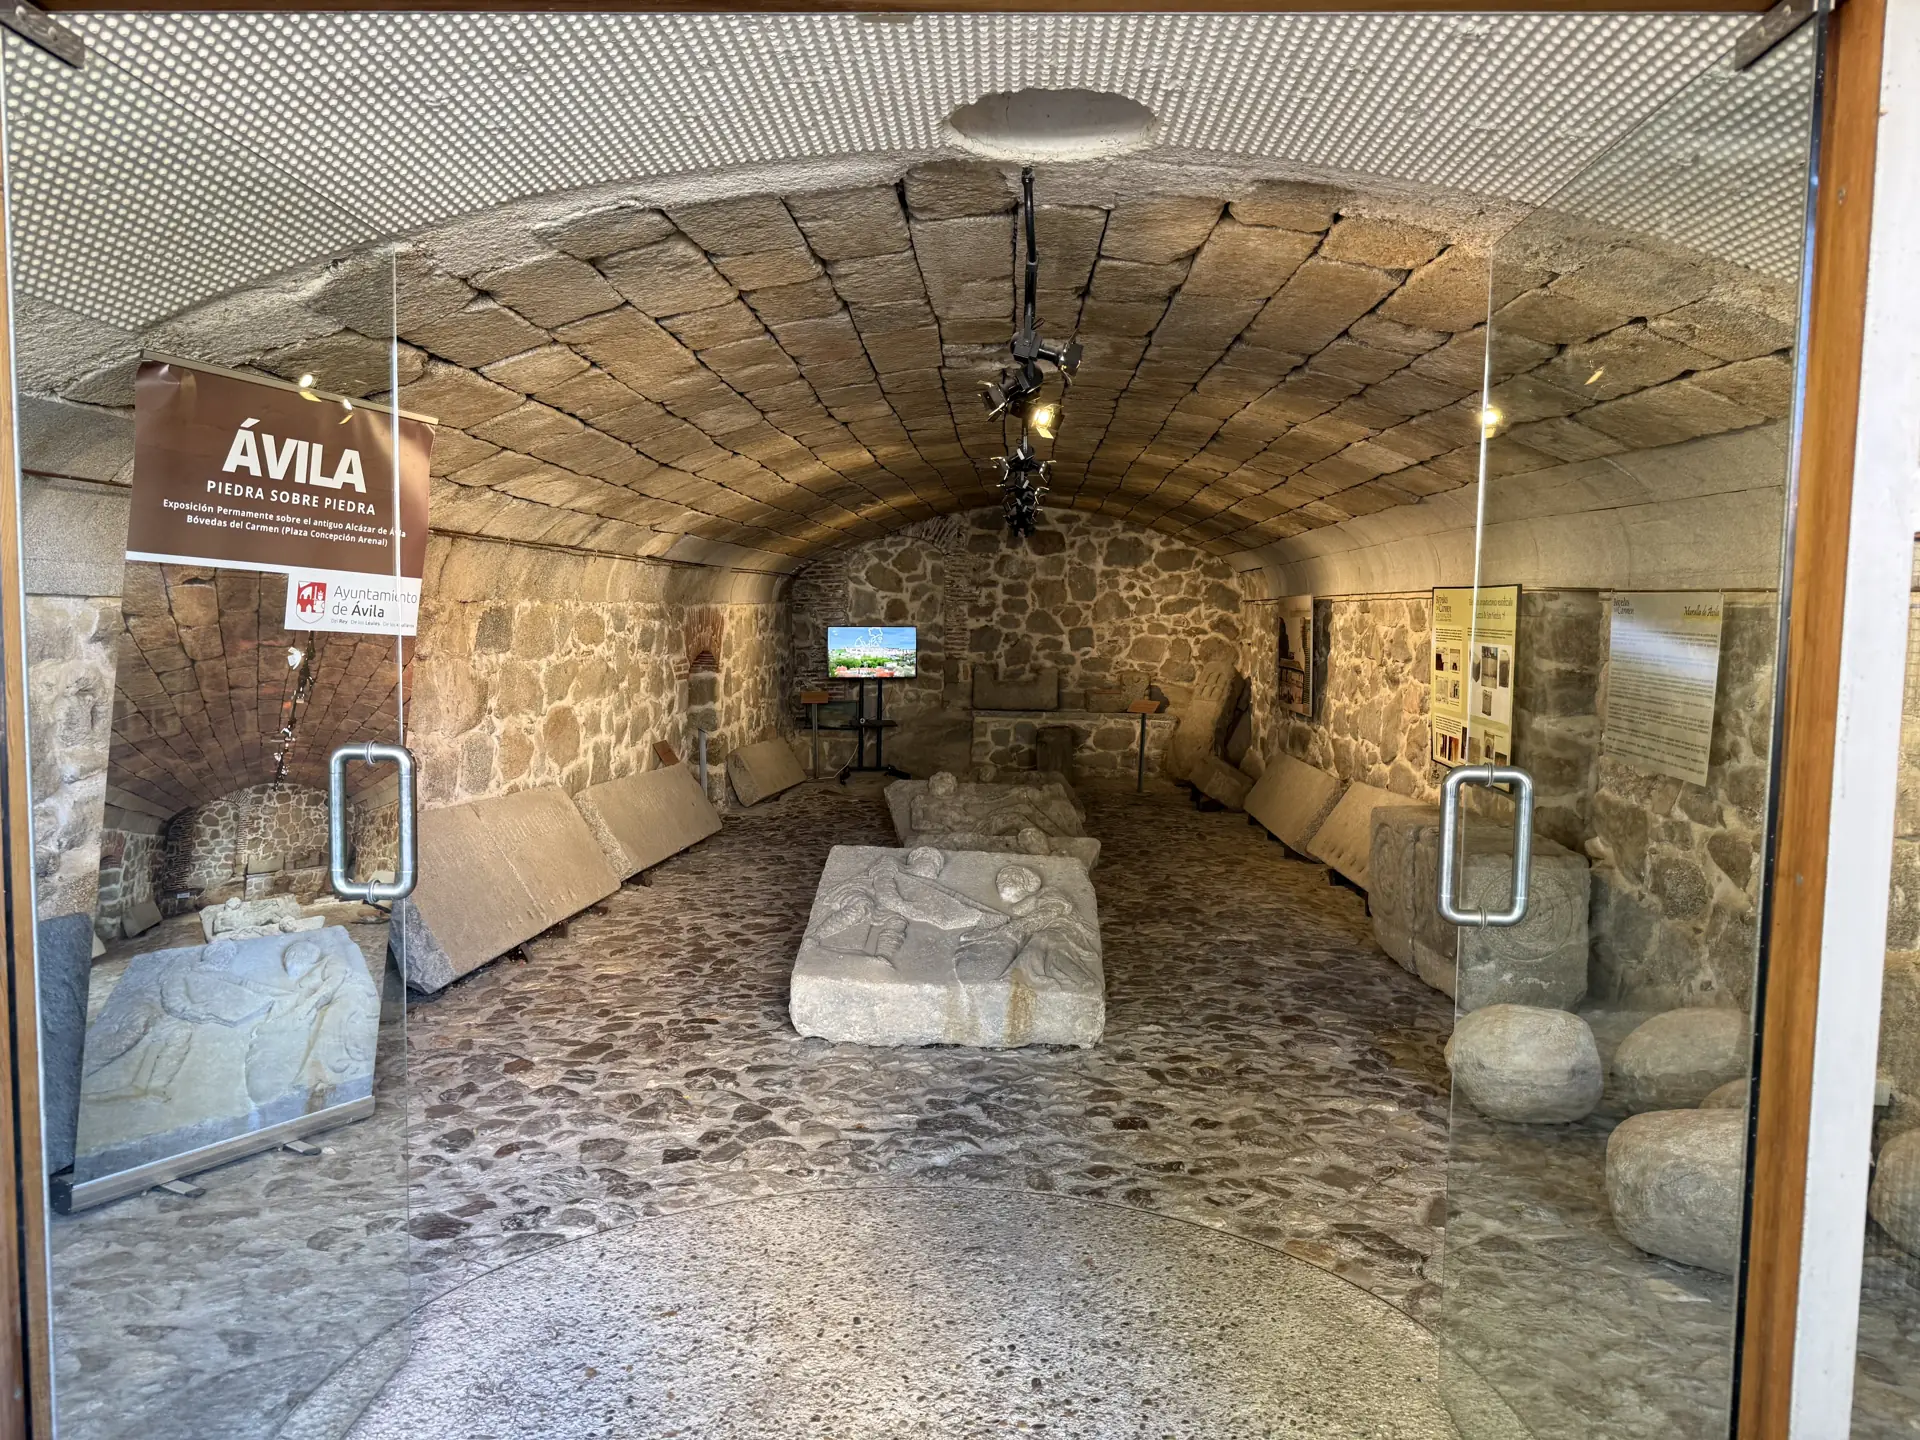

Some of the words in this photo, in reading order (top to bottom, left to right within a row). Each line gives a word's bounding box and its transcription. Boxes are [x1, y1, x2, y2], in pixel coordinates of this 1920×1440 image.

[222, 418, 367, 493] ÁVILA
[207, 480, 264, 500] PIEDRA
[270, 489, 319, 508] SOBRE
[324, 497, 376, 516] PIEDRA
[163, 498, 214, 513] Exposición
[217, 505, 274, 521] Permamente
[276, 513, 301, 524] sobre
[303, 517, 311, 525] el
[313, 518, 344, 530] antiguo
[345, 522, 376, 534] Alcázar
[377, 526, 388, 536] de
[186, 514, 228, 528] Bóvedas
[229, 519, 243, 529] del
[245, 521, 280, 534] Carmen
[281, 525, 309, 537] (Plaza
[310, 529, 356, 543] Concepción
[357, 535, 388, 548] Arenal)
[332, 601, 348, 616] de
[351, 600, 385, 618] Ávila
